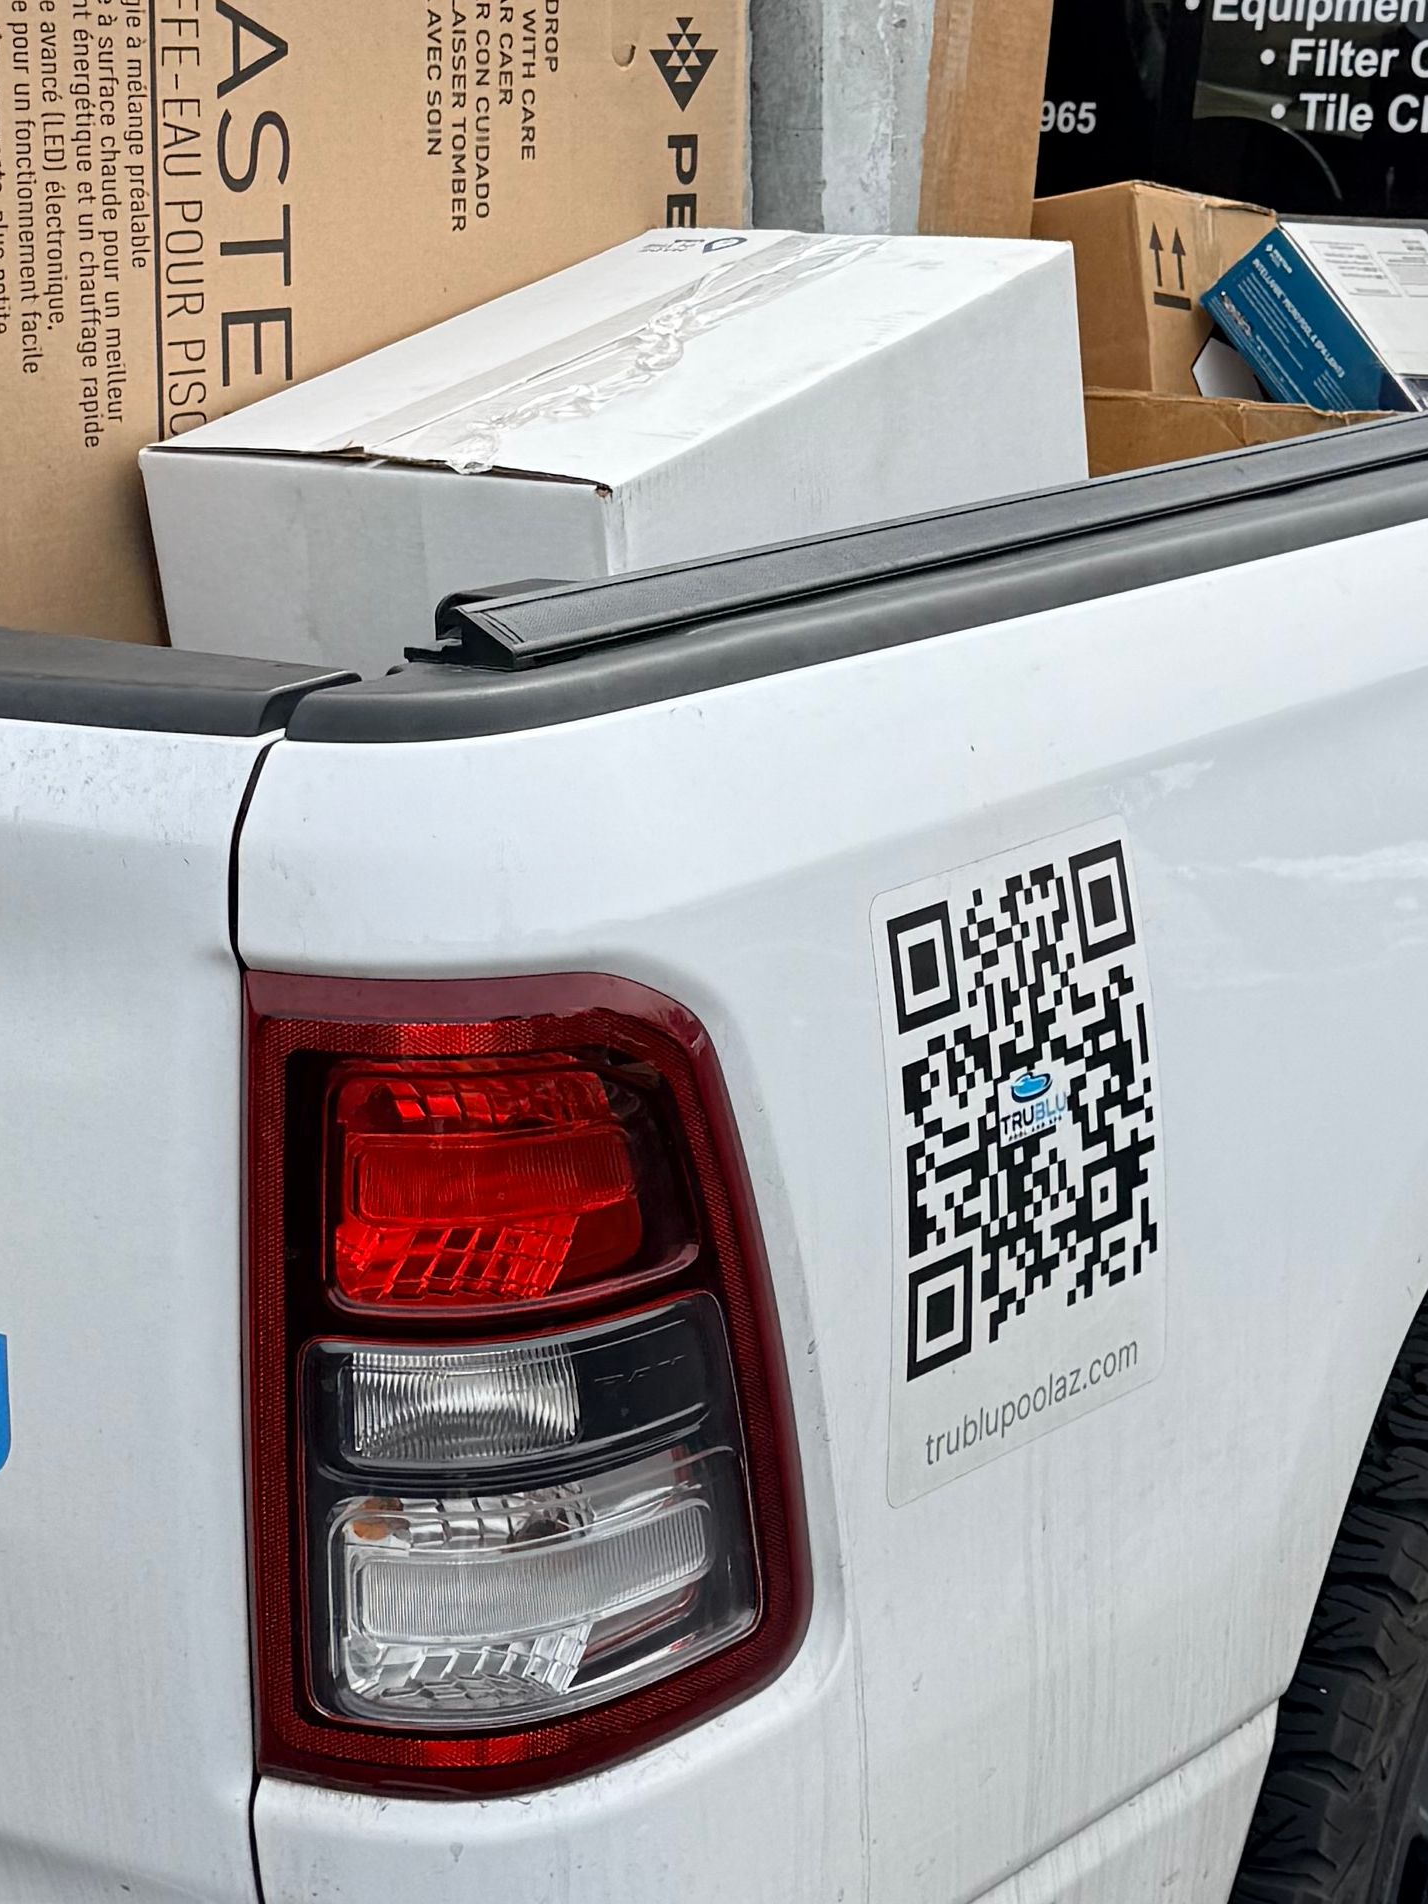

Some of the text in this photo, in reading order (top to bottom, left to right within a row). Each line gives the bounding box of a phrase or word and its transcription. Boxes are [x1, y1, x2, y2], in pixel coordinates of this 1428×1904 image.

[7, 23, 29, 73] pour
[98, 15, 117, 26] à
[127, 37, 146, 48] à
[427, 9, 442, 80] AVEC
[522, 9, 536, 78] WITH
[545, 0, 559, 72] DROP
[40, 22, 62, 102] avancé
[98, 37, 119, 125] surface
[476, 30, 490, 85] CON
[499, 33, 513, 104] CAER
[1288, 39, 1399, 77] Filter
[14, 84, 30, 110] un
[70, 29, 96, 171] énergétique
[124, 59, 147, 154] mélange
[427, 91, 442, 155] SOIN
[522, 89, 535, 160] CARE
[1040, 100, 1097, 134] 965
[1300, 93, 1373, 131] Tile
[41, 113, 67, 170] (LED)
[452, 117, 466, 231] TOMBER
[476, 97, 489, 218] CUIDADO
[15, 120, 39, 301] fonctionnement
[78, 182, 96, 204] et
[101, 136, 122, 219] chaude
[666, 133, 699, 229] PE
[79, 214, 93, 240] un
[124, 165, 151, 267] préalable
[98, 231, 118, 281] pour
[165, 200, 204, 318] POUR
[77, 252, 101, 367] chauffage
[105, 292, 119, 317] un
[22, 312, 43, 373] facile
[106, 329, 126, 422] meilleur
[79, 378, 104, 447] rapide
[167, 339, 209, 437] PISC
[1000, 1092, 1066, 1135] TRUBLU
[926, 1342, 1137, 1465] trublupoolaz.com
